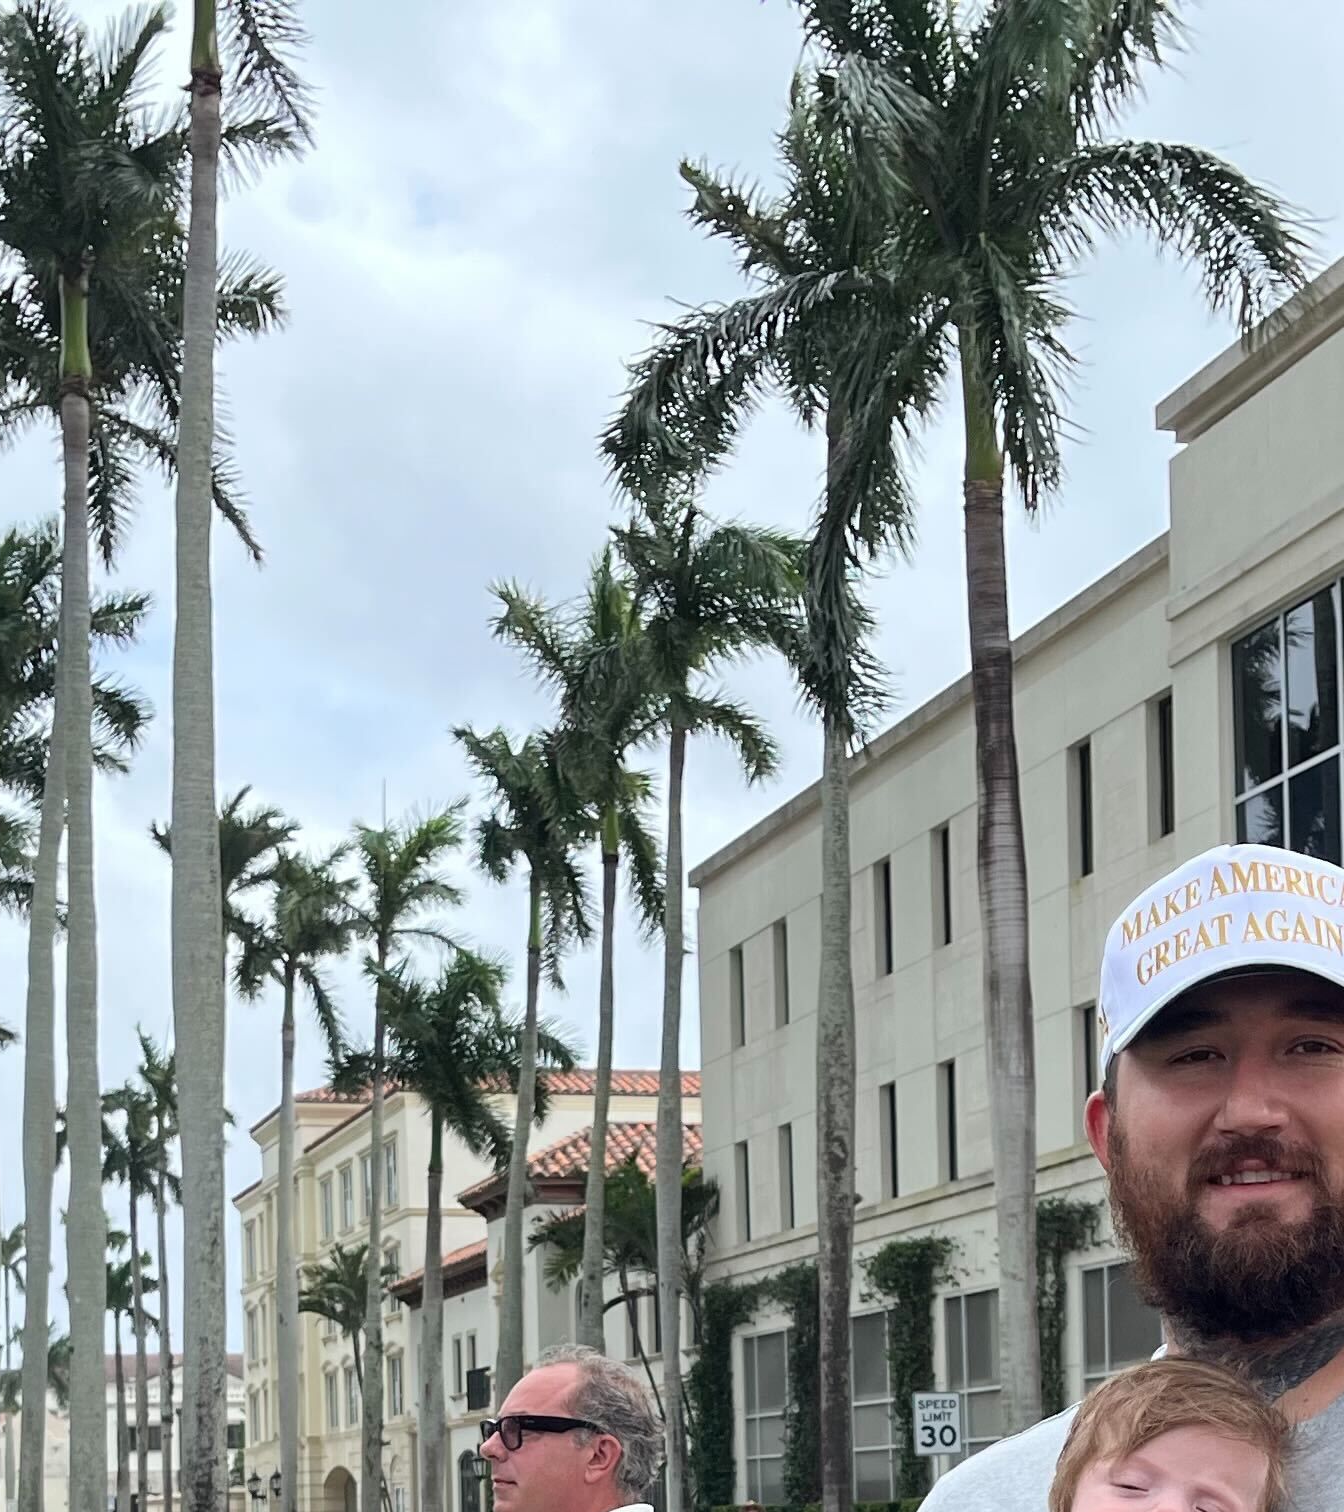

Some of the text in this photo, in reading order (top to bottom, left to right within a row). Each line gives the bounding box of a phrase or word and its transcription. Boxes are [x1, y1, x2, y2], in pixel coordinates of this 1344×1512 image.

[1120, 878, 1202, 950] MAKE
[1136, 909, 1344, 986] GREAT AGAIN
[918, 1399, 957, 1410] SPEED
[922, 1411, 953, 1422] LIMIT
[920, 1425, 957, 1448] 30
